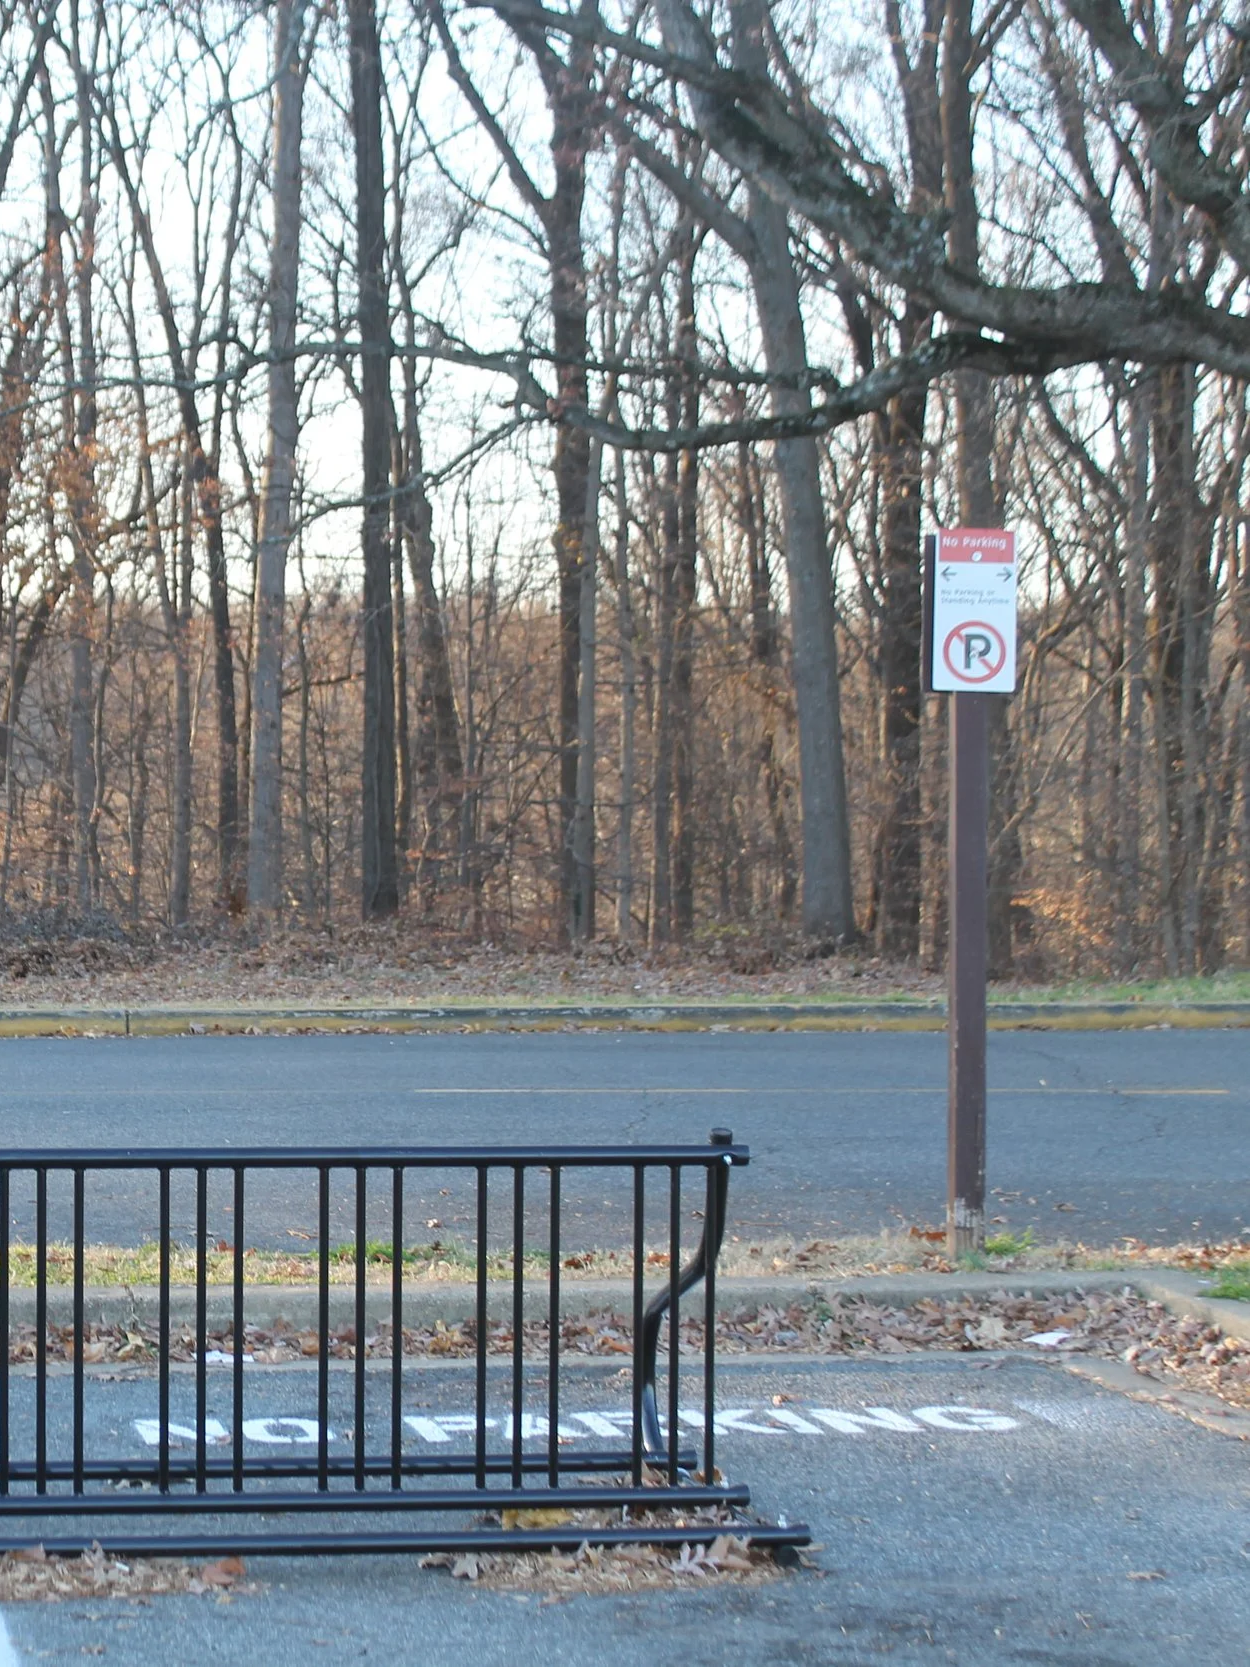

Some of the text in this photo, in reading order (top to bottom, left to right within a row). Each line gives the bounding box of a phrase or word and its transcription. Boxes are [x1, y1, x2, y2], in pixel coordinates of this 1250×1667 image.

[942, 536, 1007, 551] No Parking
[963, 633, 992, 670] P
[133, 1405, 1019, 1445] NO PARKING
